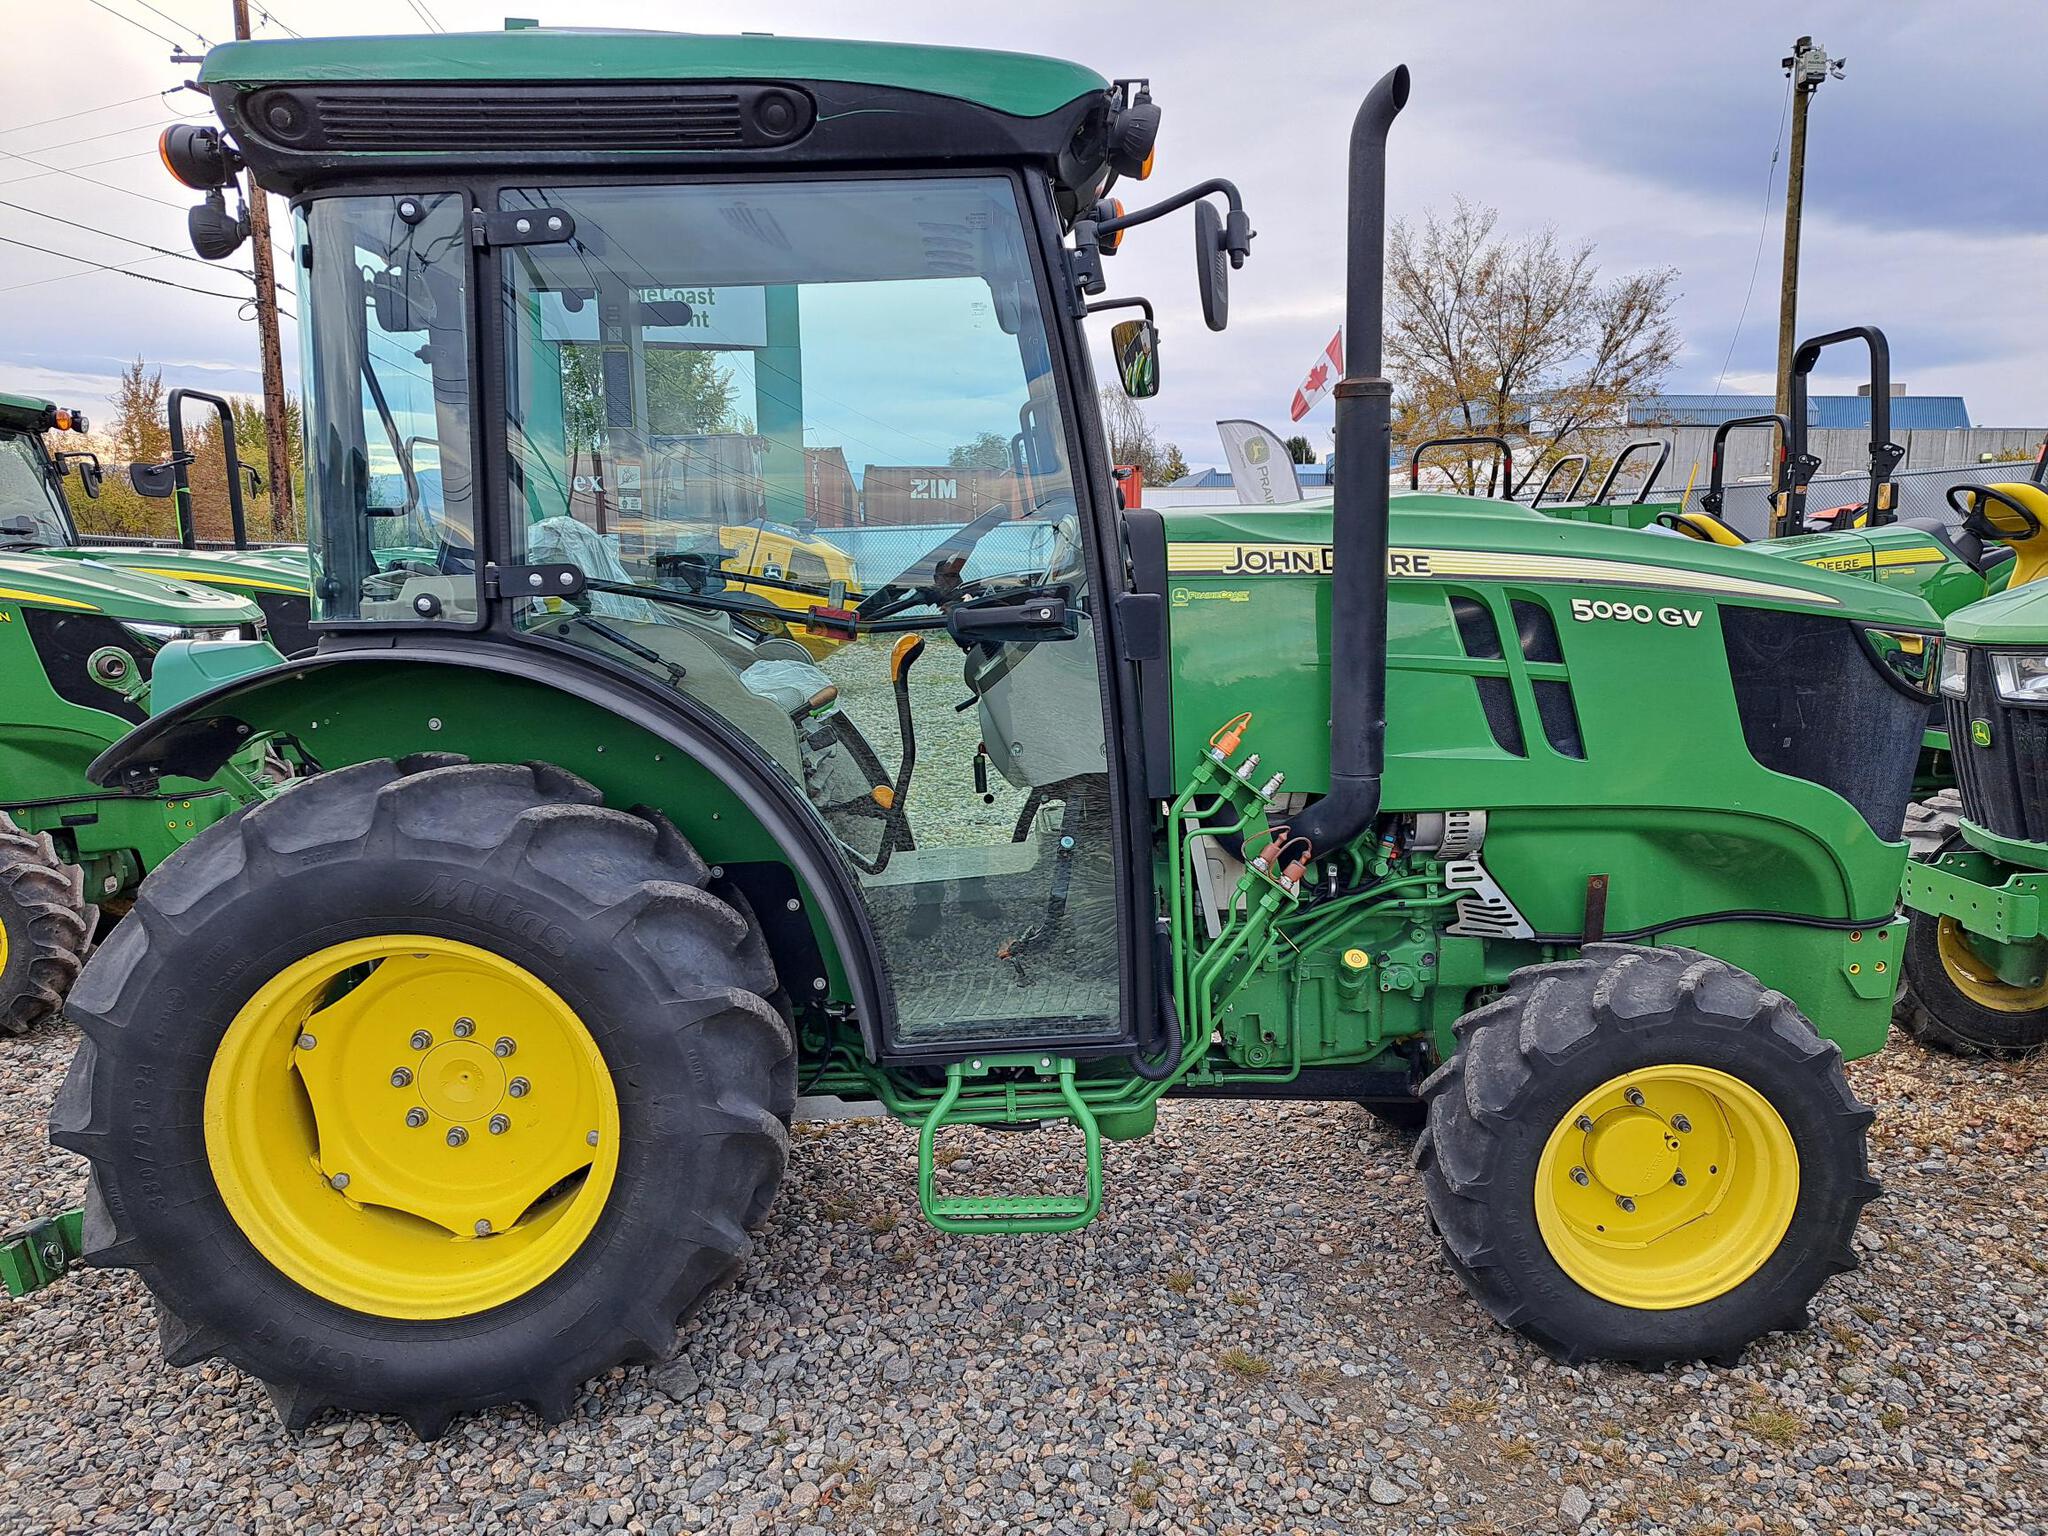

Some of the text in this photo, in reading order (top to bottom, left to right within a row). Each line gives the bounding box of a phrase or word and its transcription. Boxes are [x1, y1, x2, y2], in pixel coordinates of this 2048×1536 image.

[910, 479, 957, 499] ZIM
[1226, 547, 1313, 570] JOHN
[1570, 598, 1704, 628] 5090 GV
